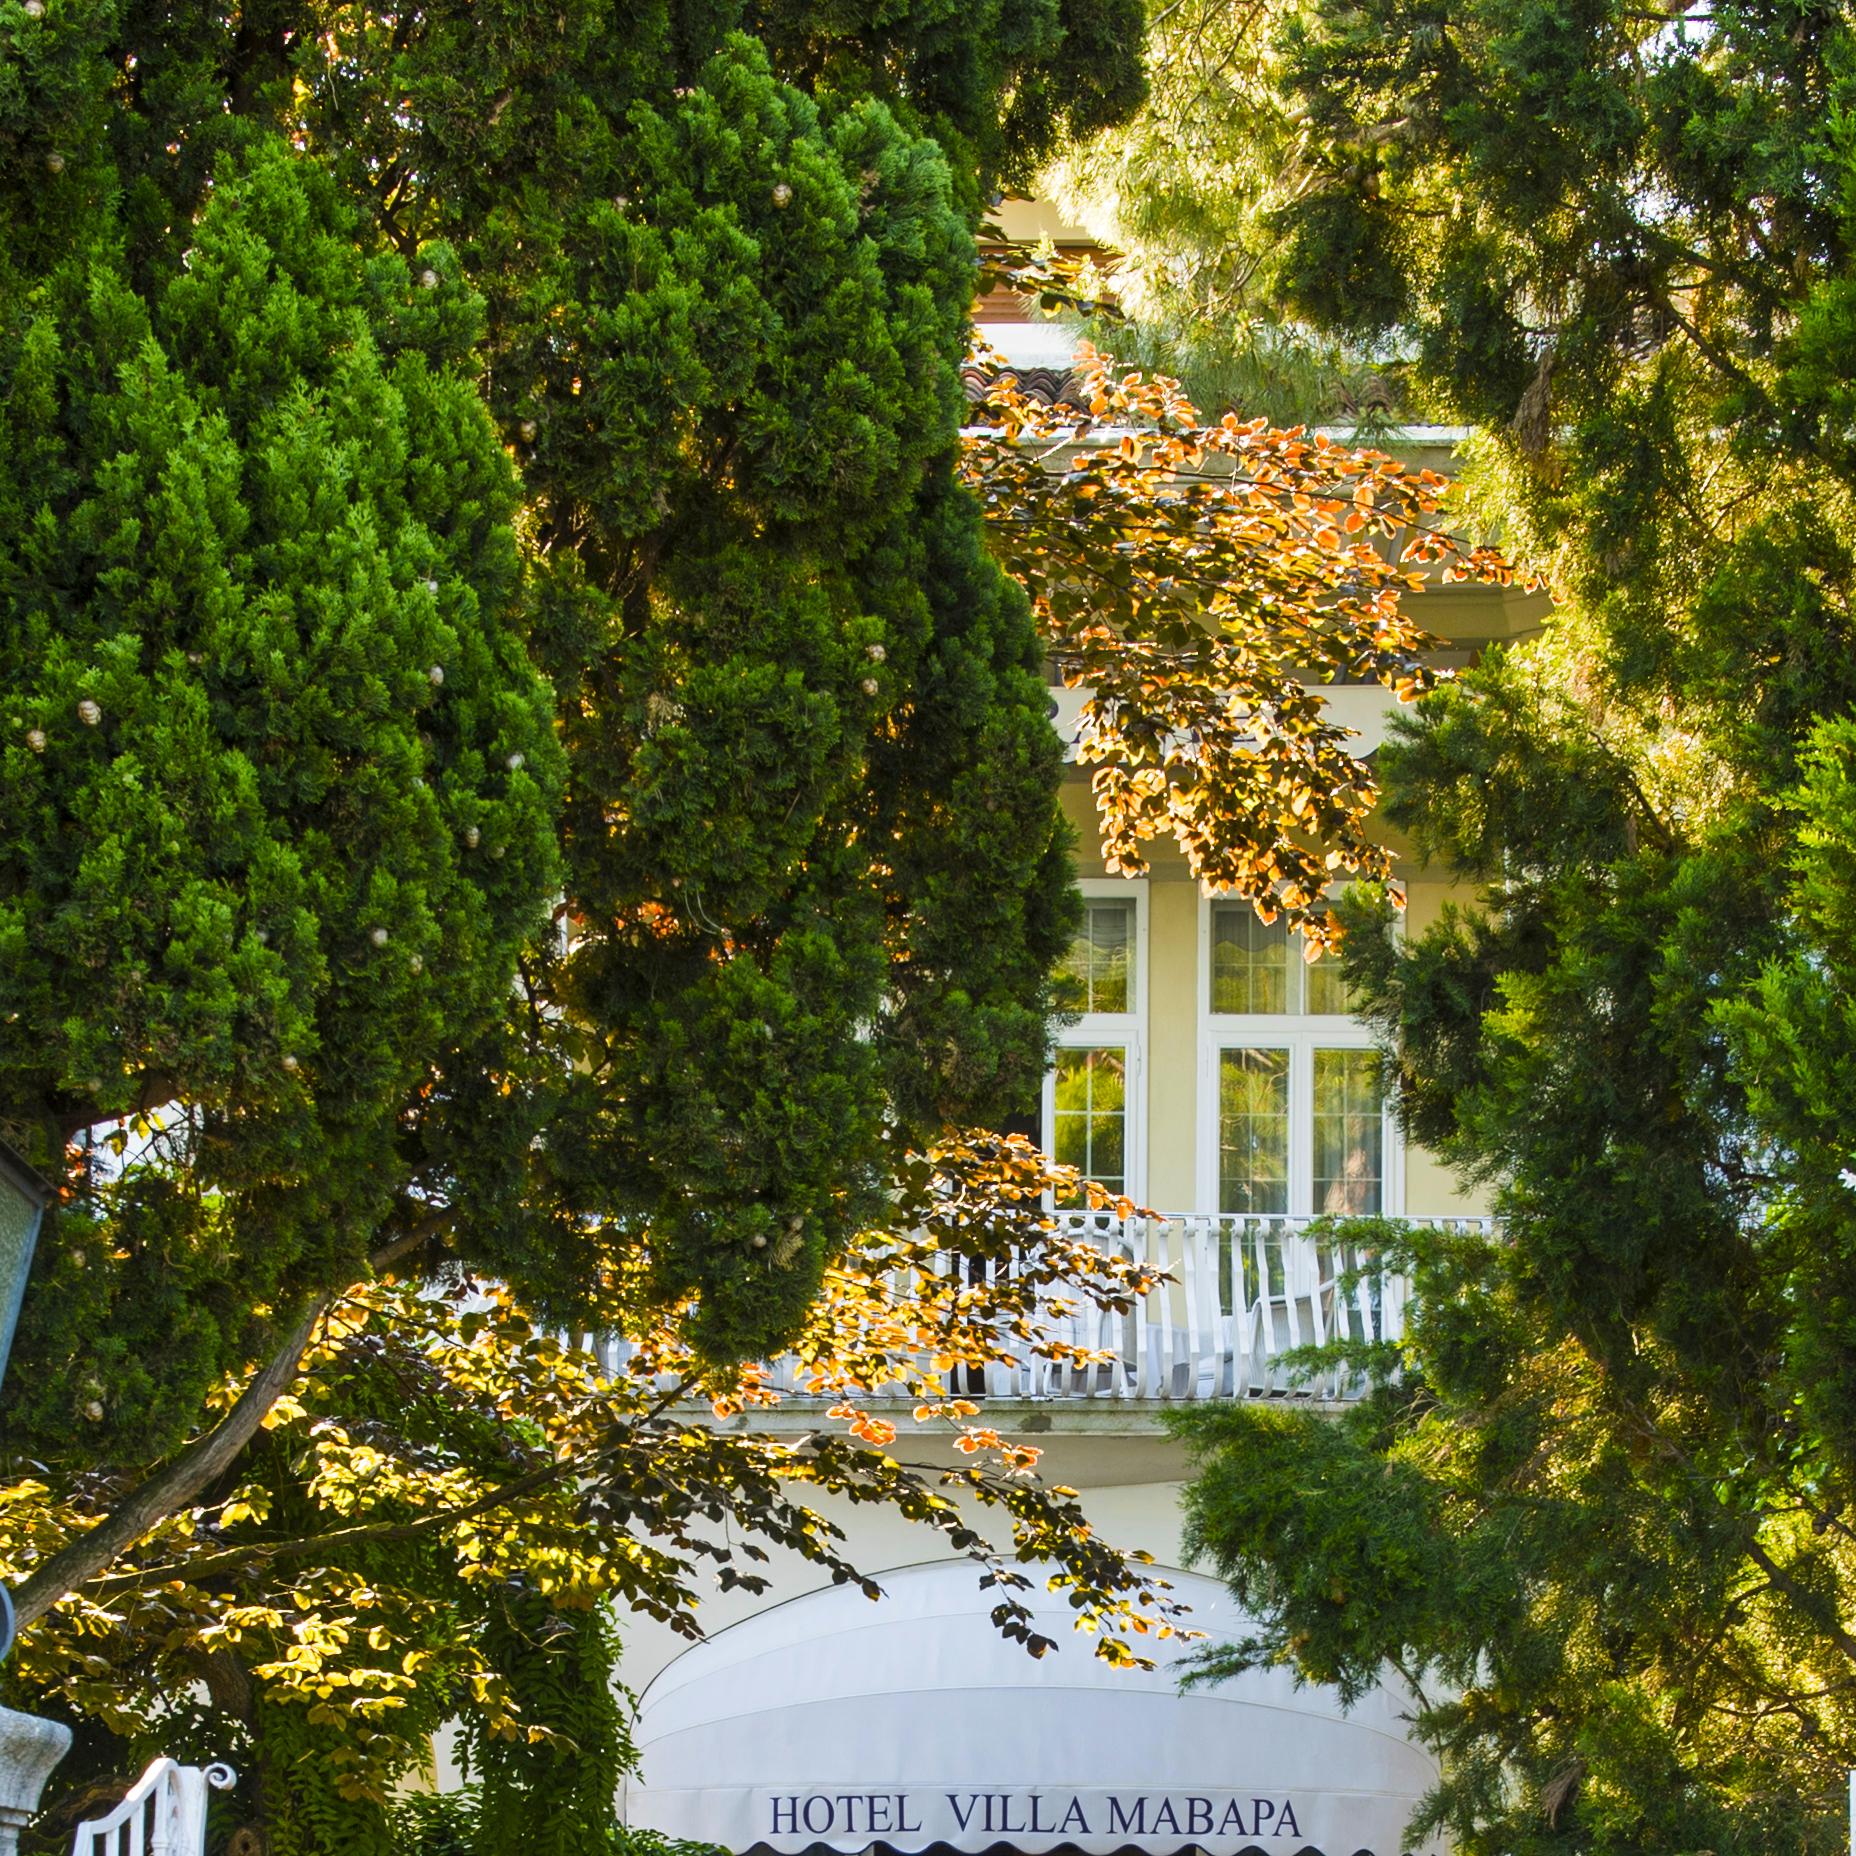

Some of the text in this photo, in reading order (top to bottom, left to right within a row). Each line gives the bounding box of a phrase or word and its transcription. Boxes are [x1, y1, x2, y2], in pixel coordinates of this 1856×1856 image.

[769, 1794, 1303, 1838] HOTEL VILLA MABAPA
